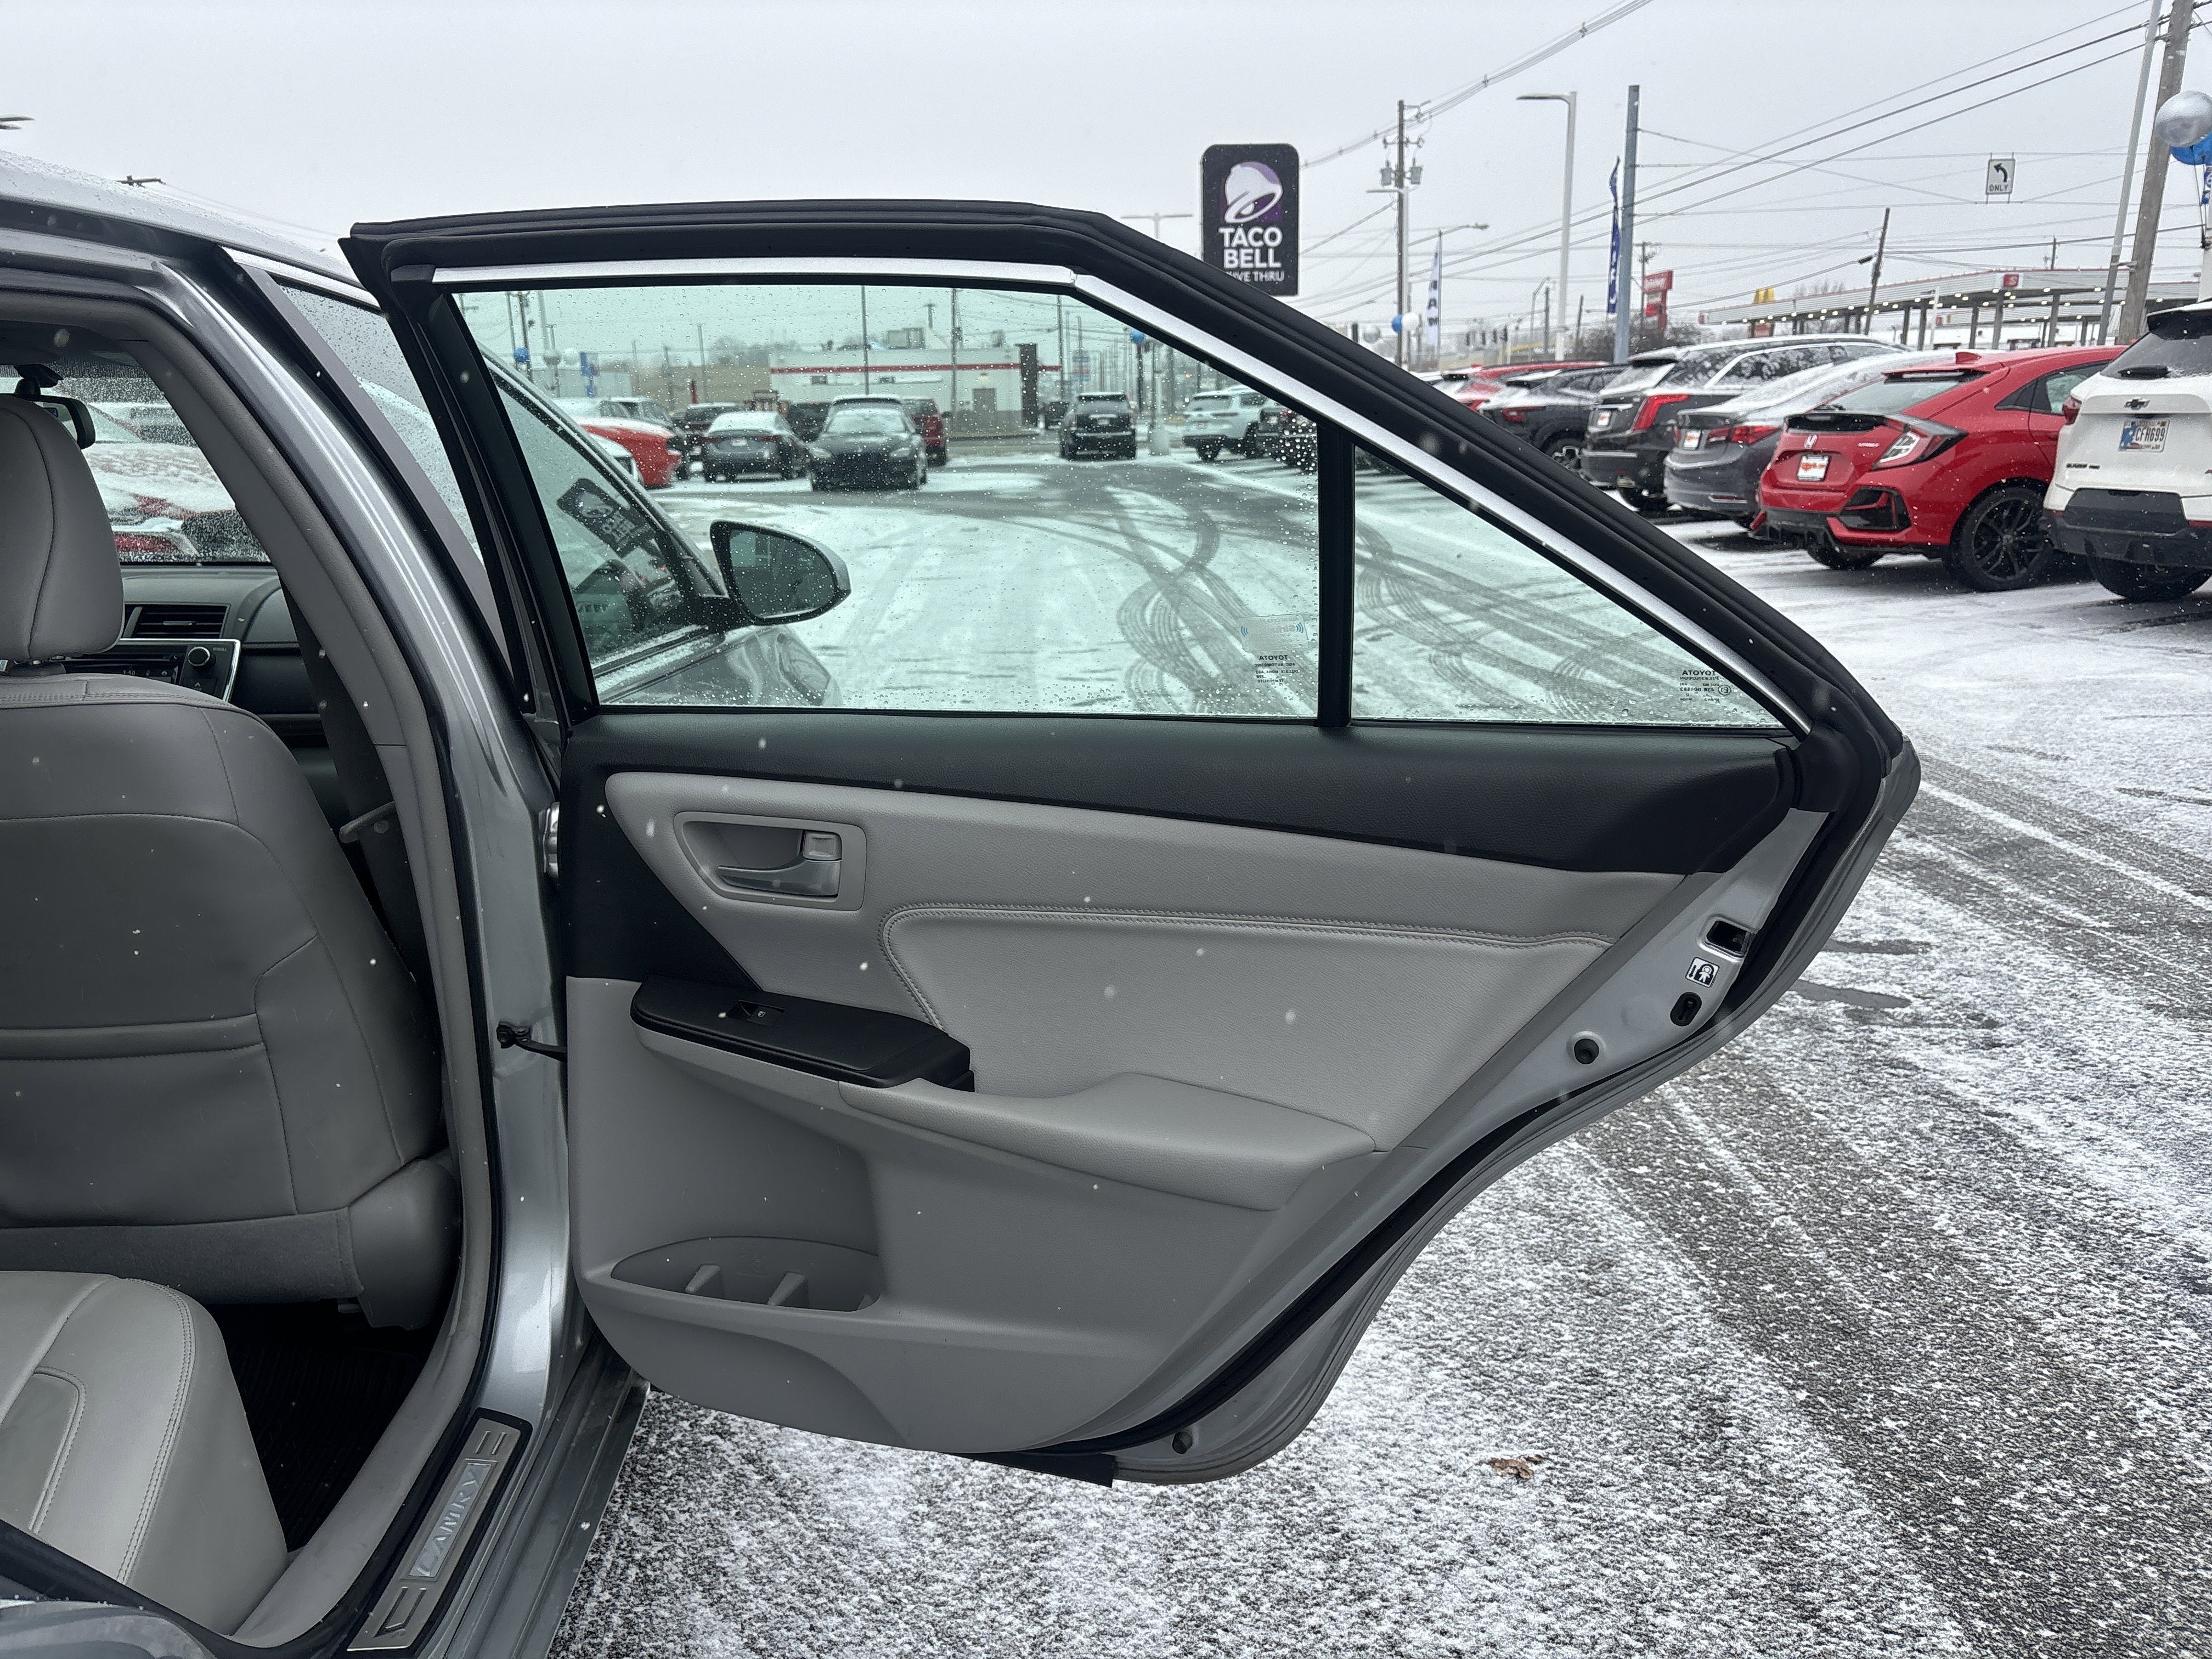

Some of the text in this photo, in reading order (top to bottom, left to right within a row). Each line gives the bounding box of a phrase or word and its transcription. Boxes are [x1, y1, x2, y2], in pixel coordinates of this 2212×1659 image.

[1989, 184, 2009, 192] ONLY
[1218, 225, 1283, 247] TACO
[1223, 247, 1282, 269] BELL
[1252, 270, 1285, 282] THRU
[415, 1468, 482, 1577] CAMRY
